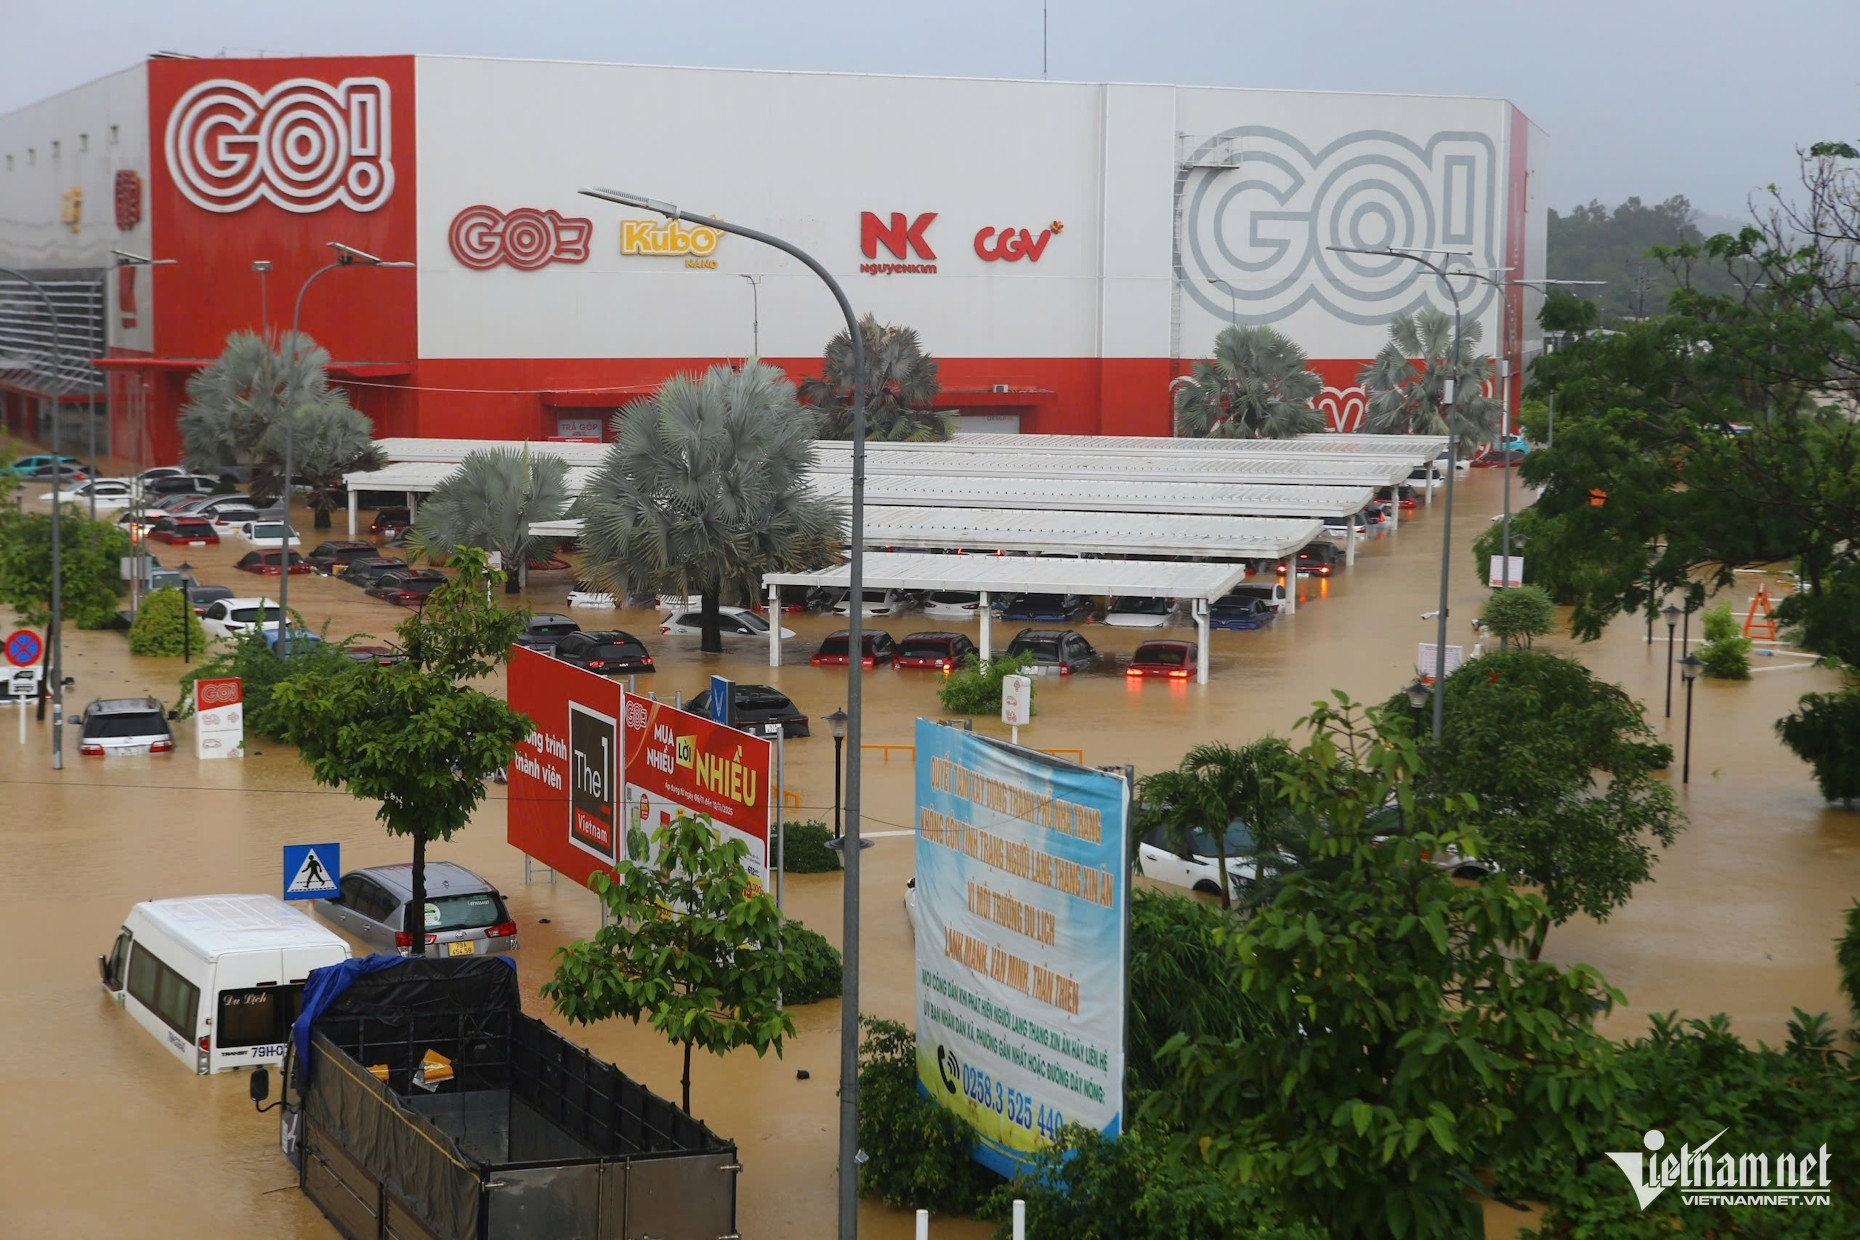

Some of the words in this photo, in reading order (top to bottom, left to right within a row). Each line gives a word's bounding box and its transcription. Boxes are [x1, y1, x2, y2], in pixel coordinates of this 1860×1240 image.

[164, 76, 395, 213] GO!
[861, 211, 938, 260] NK
[974, 226, 1051, 262] CGV
[1177, 125, 1496, 325] GO!
[545, 733, 567, 760] trình
[654, 722, 674, 747] MUA
[542, 764, 562, 790] viên
[696, 745, 757, 807] NHIỀU
[577, 813, 608, 843] Vietnam
[920, 803, 944, 844] KHÔNG
[223, 994, 240, 1006] Du
[963, 1063, 1003, 1115] 0258.3
[1008, 1087, 1032, 1130] 525
